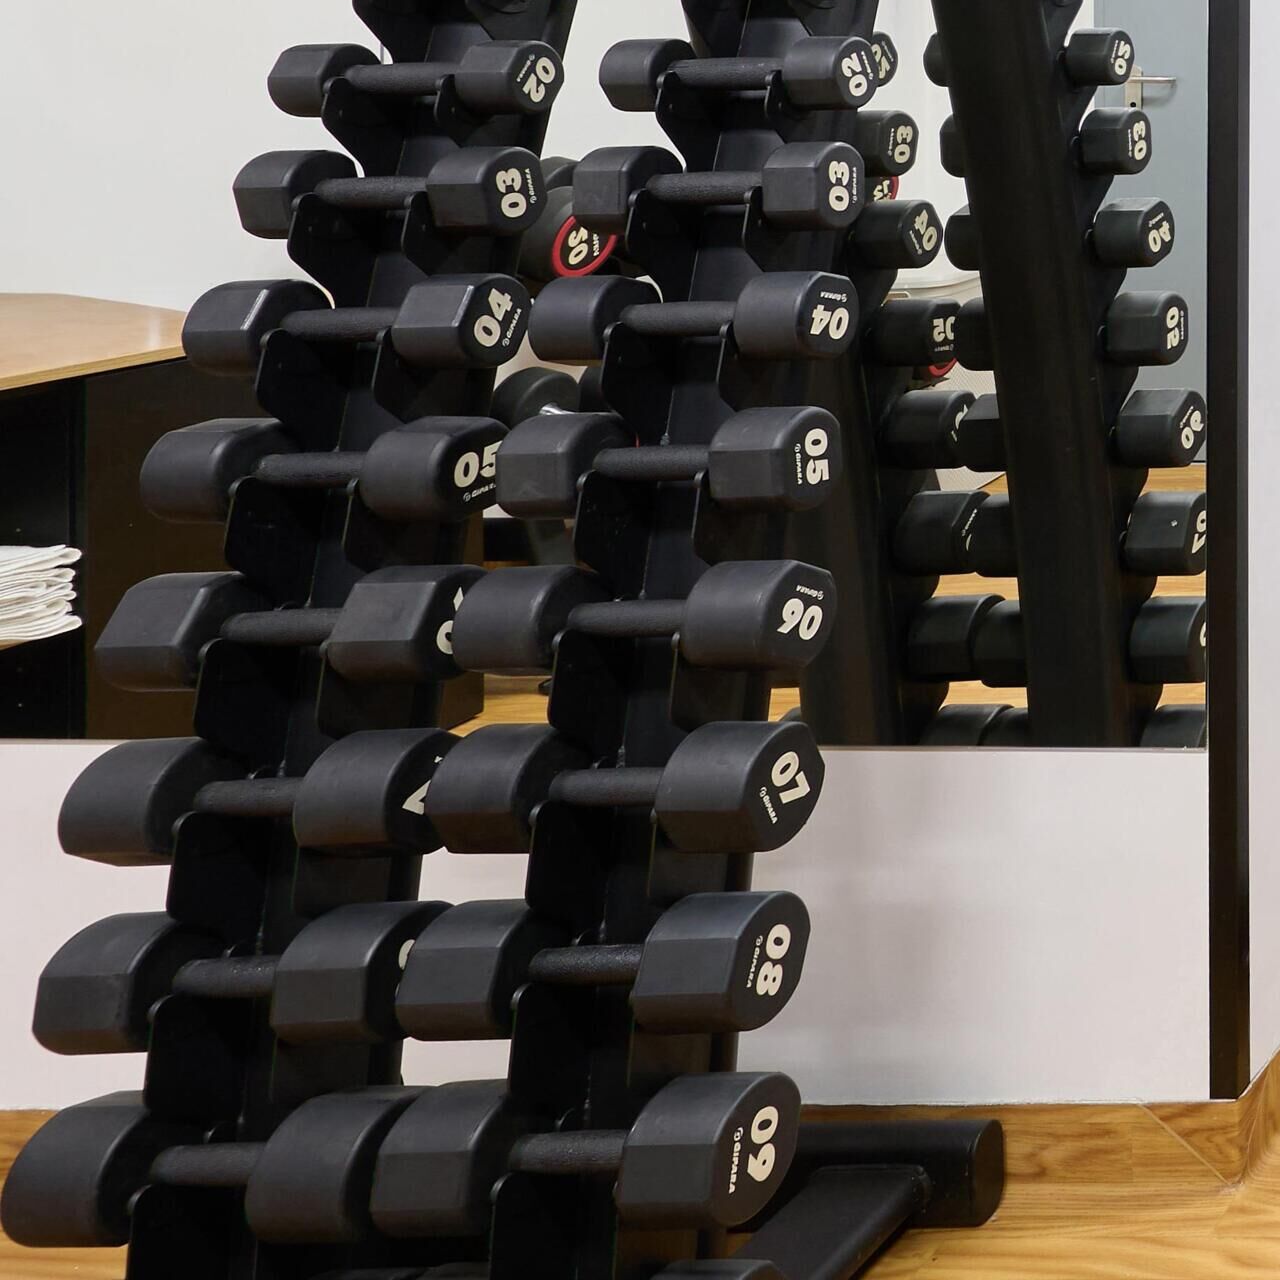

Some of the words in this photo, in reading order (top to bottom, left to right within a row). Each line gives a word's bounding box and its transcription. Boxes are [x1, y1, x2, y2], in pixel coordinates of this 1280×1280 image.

[522, 56, 556, 103] 02
[841, 52, 868, 97] 02
[496, 168, 527, 218] 03
[829, 160, 850, 212] 03
[474, 288, 513, 348] 04
[810, 304, 850, 340] 04
[454, 440, 503, 488] 05
[804, 428, 830, 485] 05
[777, 597, 823, 641] 06
[771, 751, 811, 804] 07
[756, 923, 792, 996] 08
[747, 1105, 779, 1182] 09
